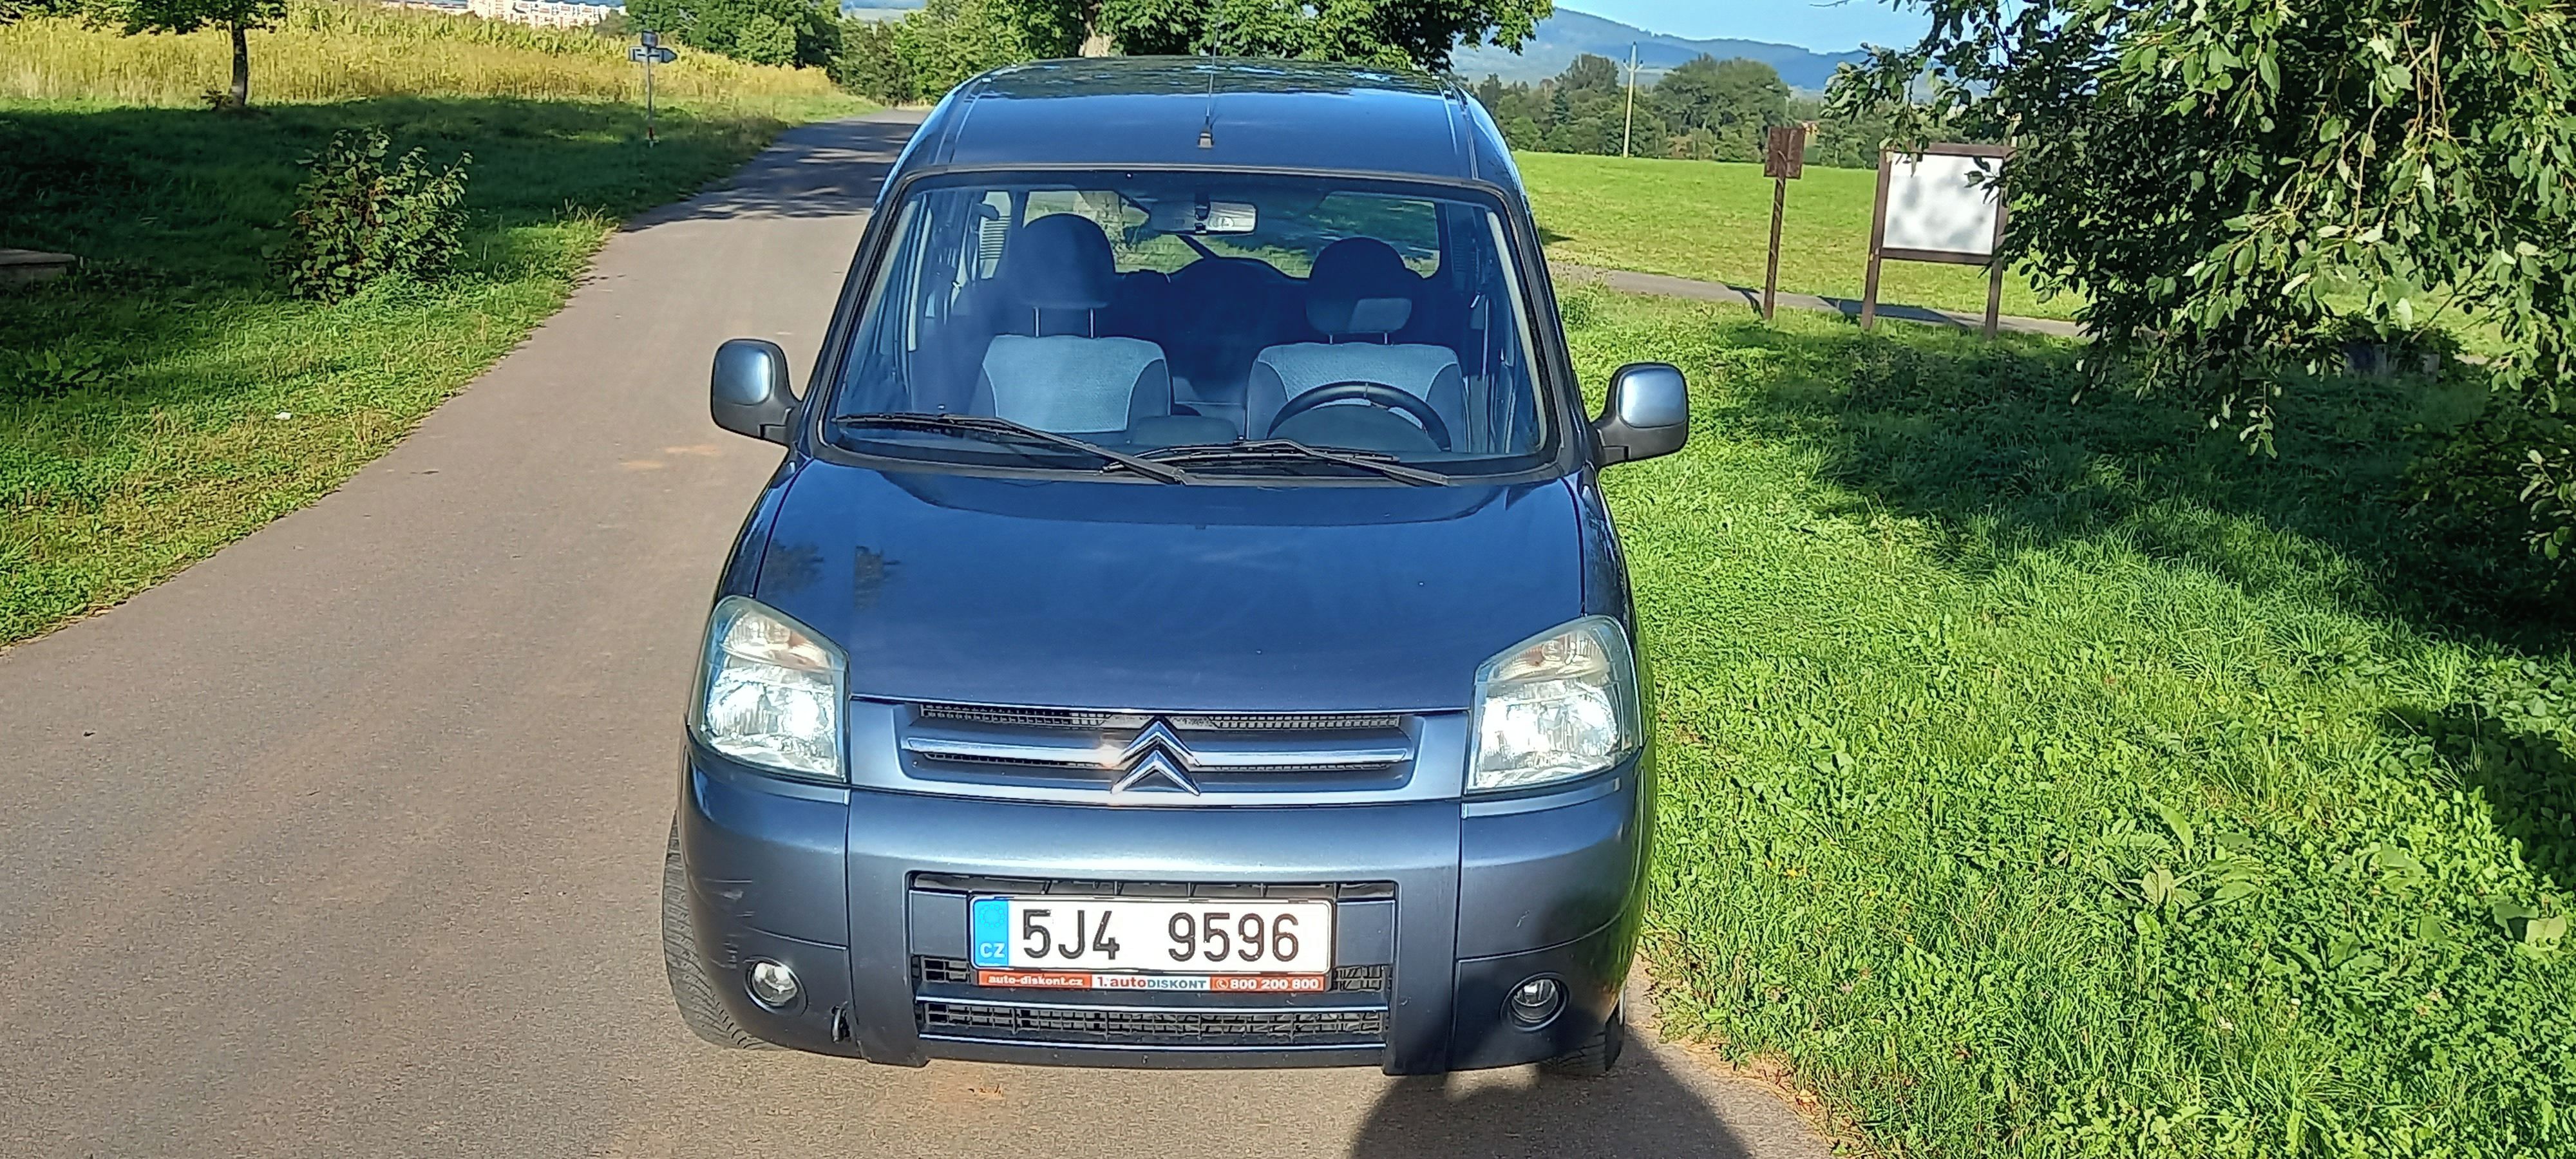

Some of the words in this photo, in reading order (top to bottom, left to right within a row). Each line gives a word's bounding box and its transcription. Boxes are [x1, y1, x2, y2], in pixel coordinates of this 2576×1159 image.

[1023, 909, 1121, 960] 5J4
[1168, 912, 1299, 962] 9596
[980, 942, 1005, 958] CZ
[987, 974, 1084, 986] auto-diskont.cz
[1229, 977, 1257, 990] 800
[1260, 978, 1289, 990] 200
